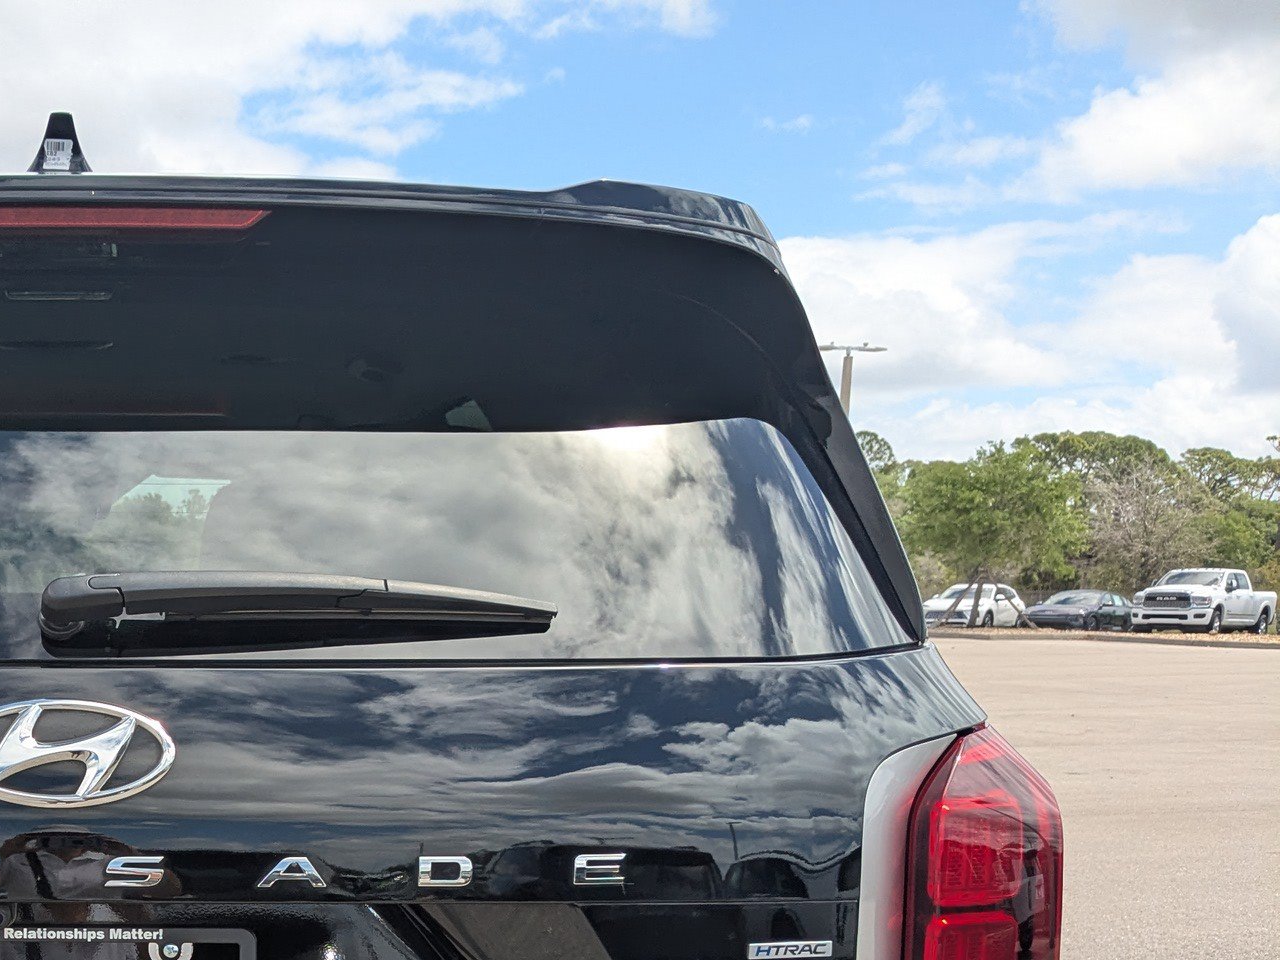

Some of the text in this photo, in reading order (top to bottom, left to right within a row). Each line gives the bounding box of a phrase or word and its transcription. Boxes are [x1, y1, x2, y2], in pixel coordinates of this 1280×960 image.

[3, 928, 106, 942] Relationships
[109, 928, 164, 940] Matter!
[755, 943, 827, 957] HTRAC
